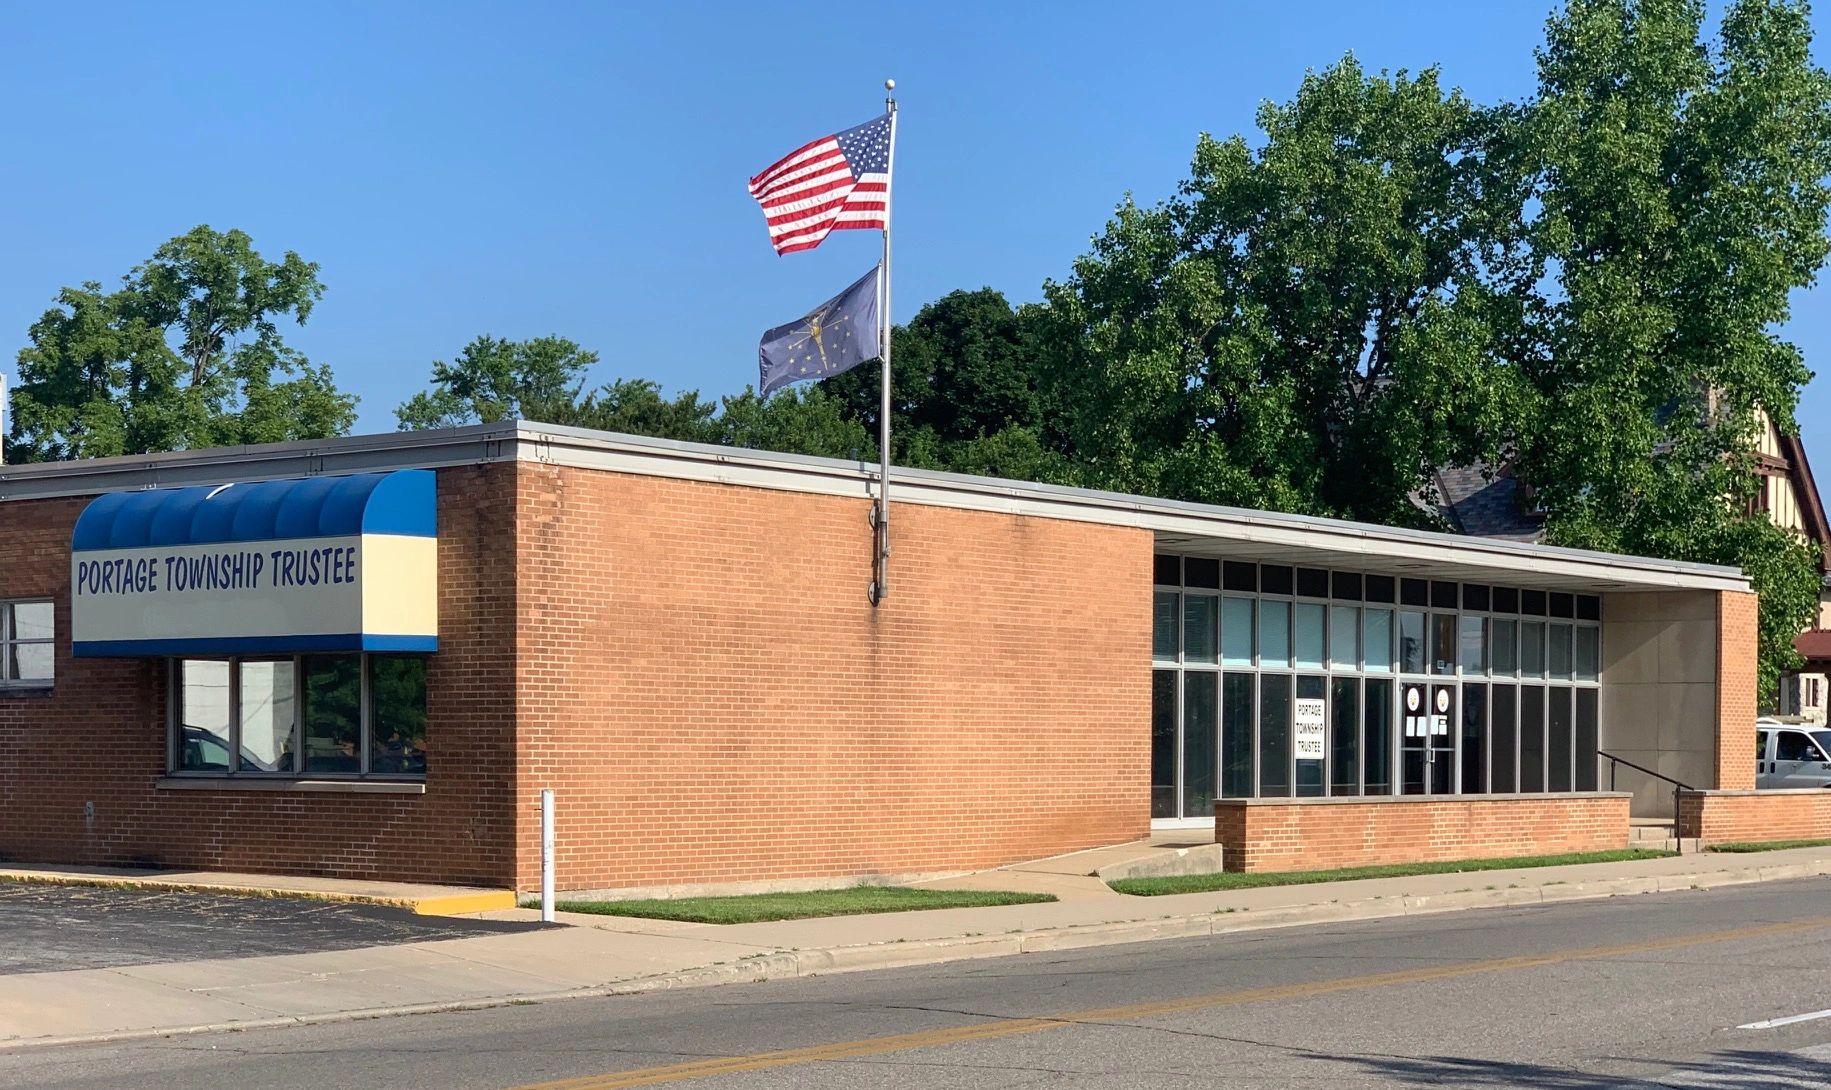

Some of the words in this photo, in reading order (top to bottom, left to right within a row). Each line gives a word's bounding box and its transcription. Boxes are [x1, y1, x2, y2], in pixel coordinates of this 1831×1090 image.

[78, 558, 158, 595] PORTAGE
[165, 552, 264, 592] TOWNSHIP
[271, 547, 356, 587] TRUSTEE
[1298, 704, 1321, 716] PORTAGE
[1296, 722, 1323, 734] TOWNSHIP
[1298, 740, 1321, 752] TRUSTEE
